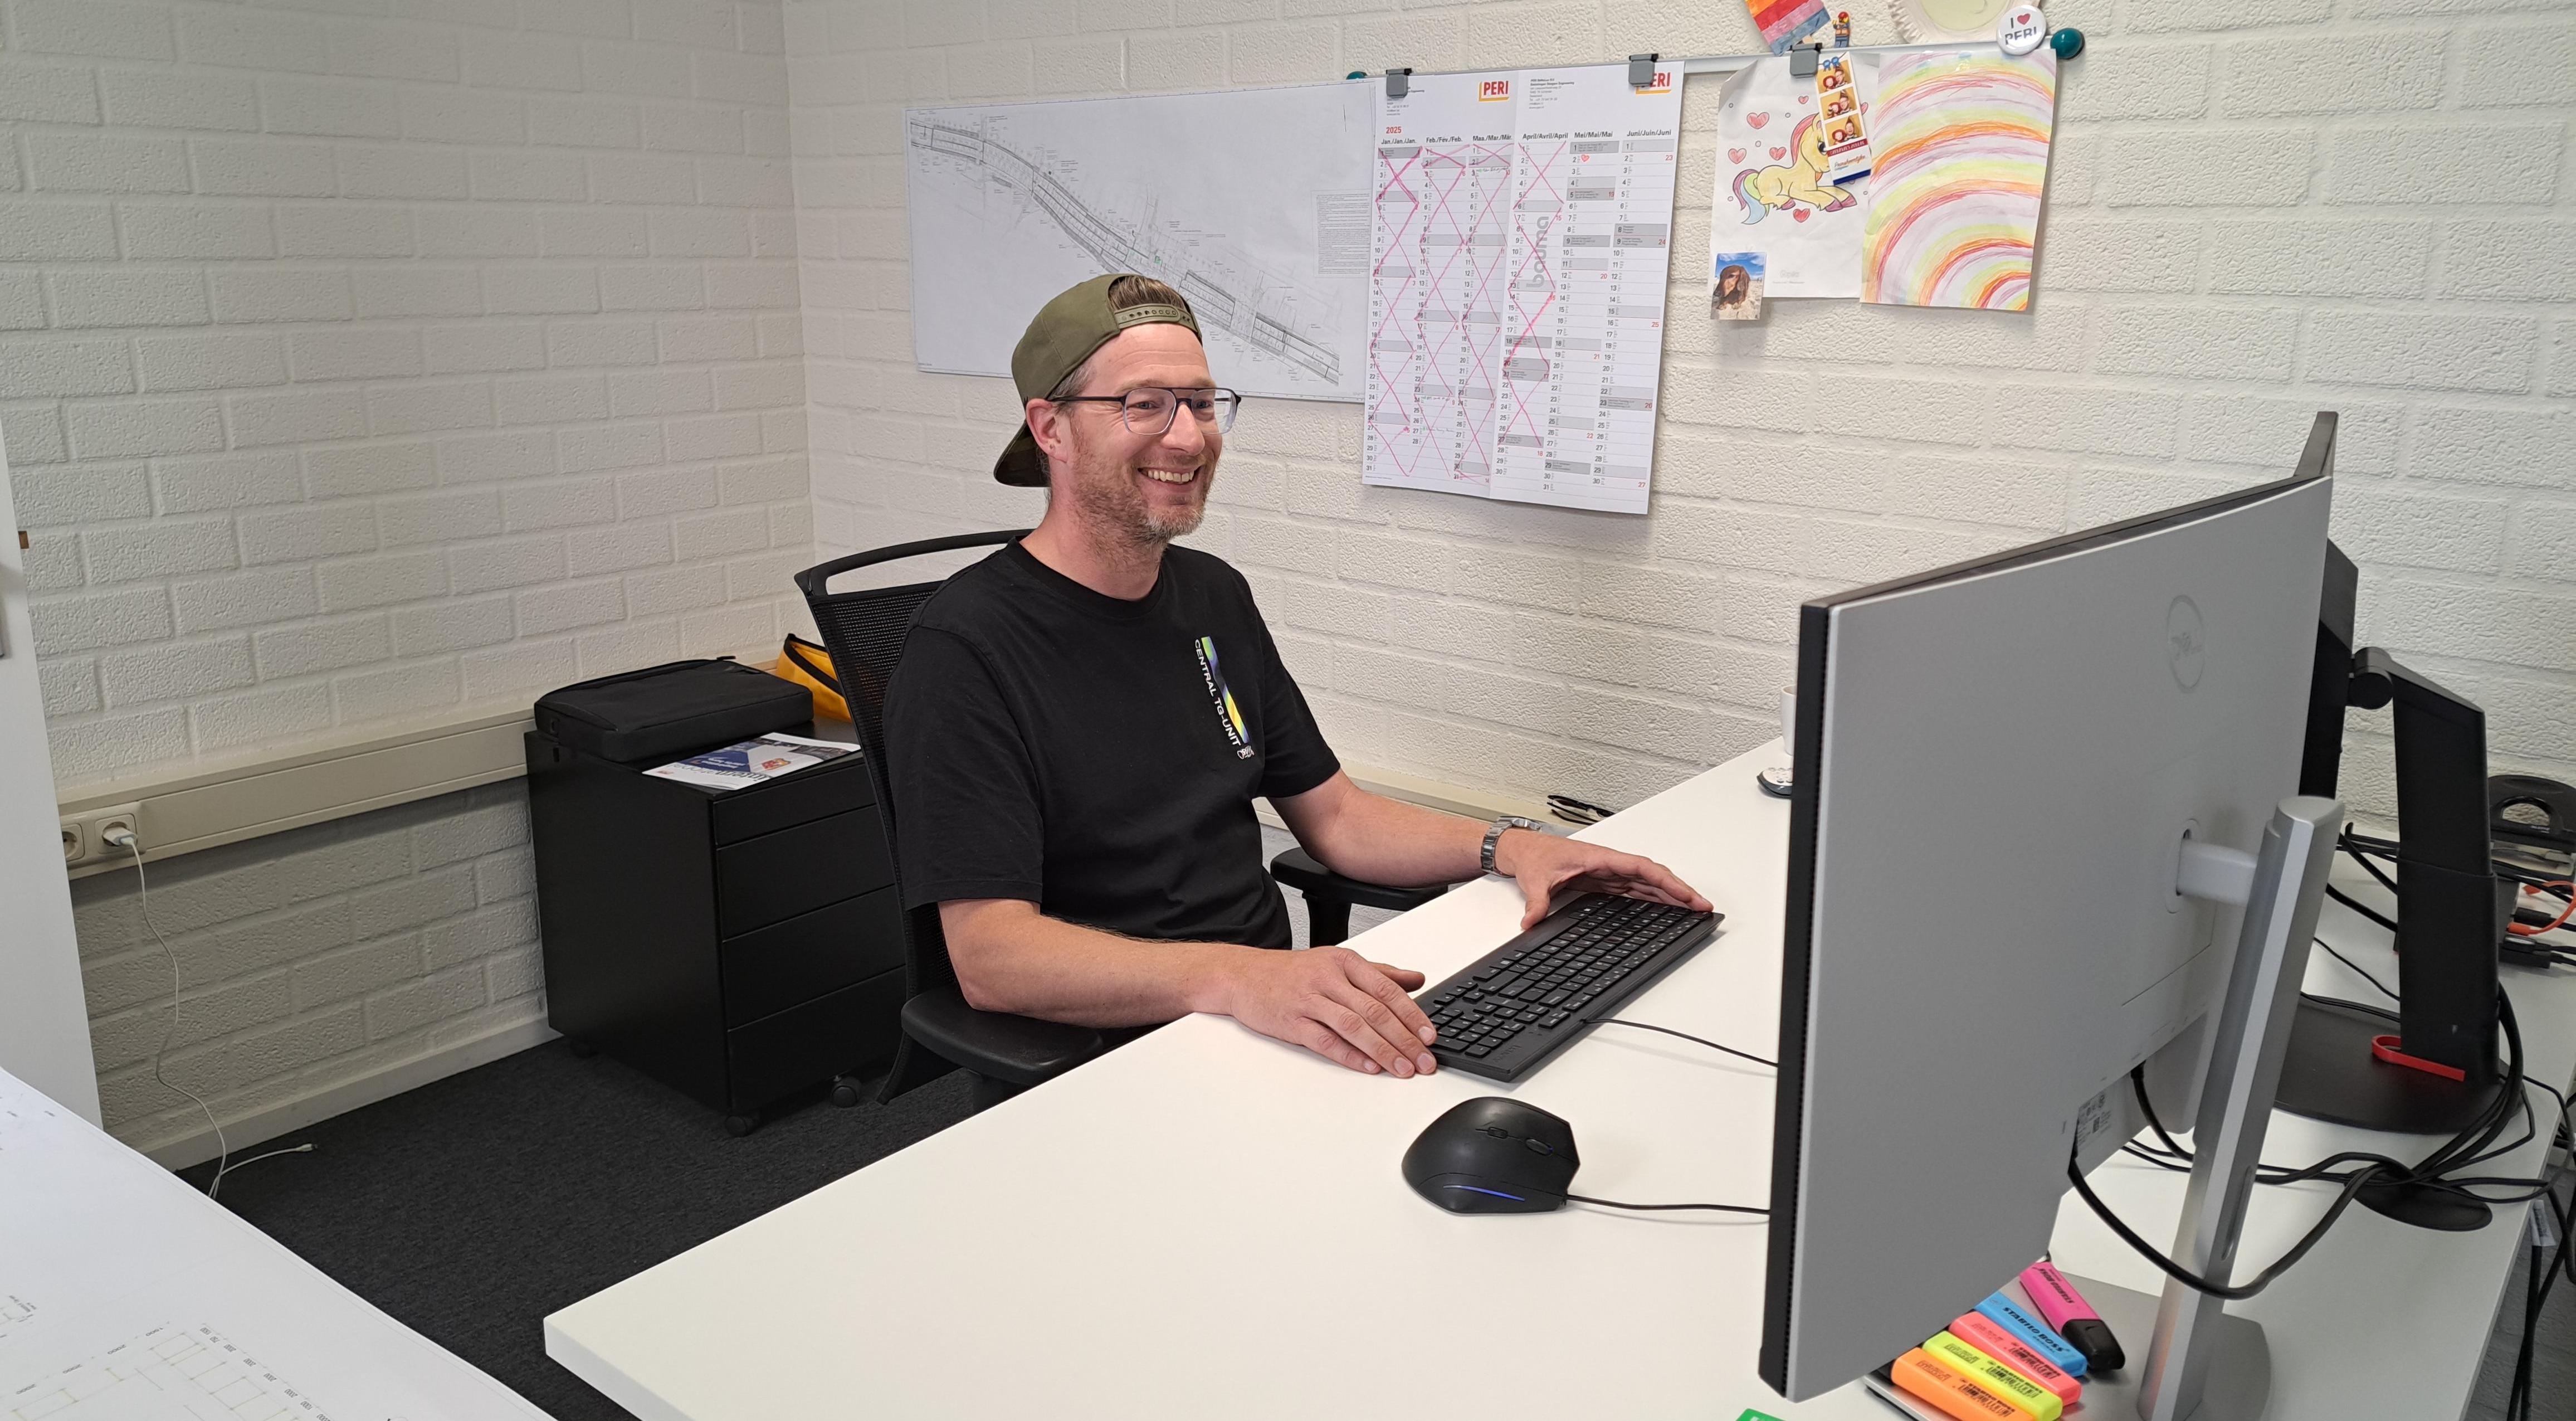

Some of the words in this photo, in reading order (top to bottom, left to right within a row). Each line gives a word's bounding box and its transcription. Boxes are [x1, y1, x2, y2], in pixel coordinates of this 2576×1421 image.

[2011, 17, 2014, 29] I
[2004, 26, 2037, 45] PERI
[1484, 80, 1509, 95] PERI
[1526, 216, 1549, 288] bauma
[1195, 639, 1217, 697] CENTRAL
[1214, 697, 1241, 746] TG-UNIT
[2038, 1268, 2054, 1283] BOSS
[2050, 1282, 2074, 1304] STABILO
[2002, 1307, 2038, 1334] STABILO
[2038, 1333, 2065, 1352] BOSS
